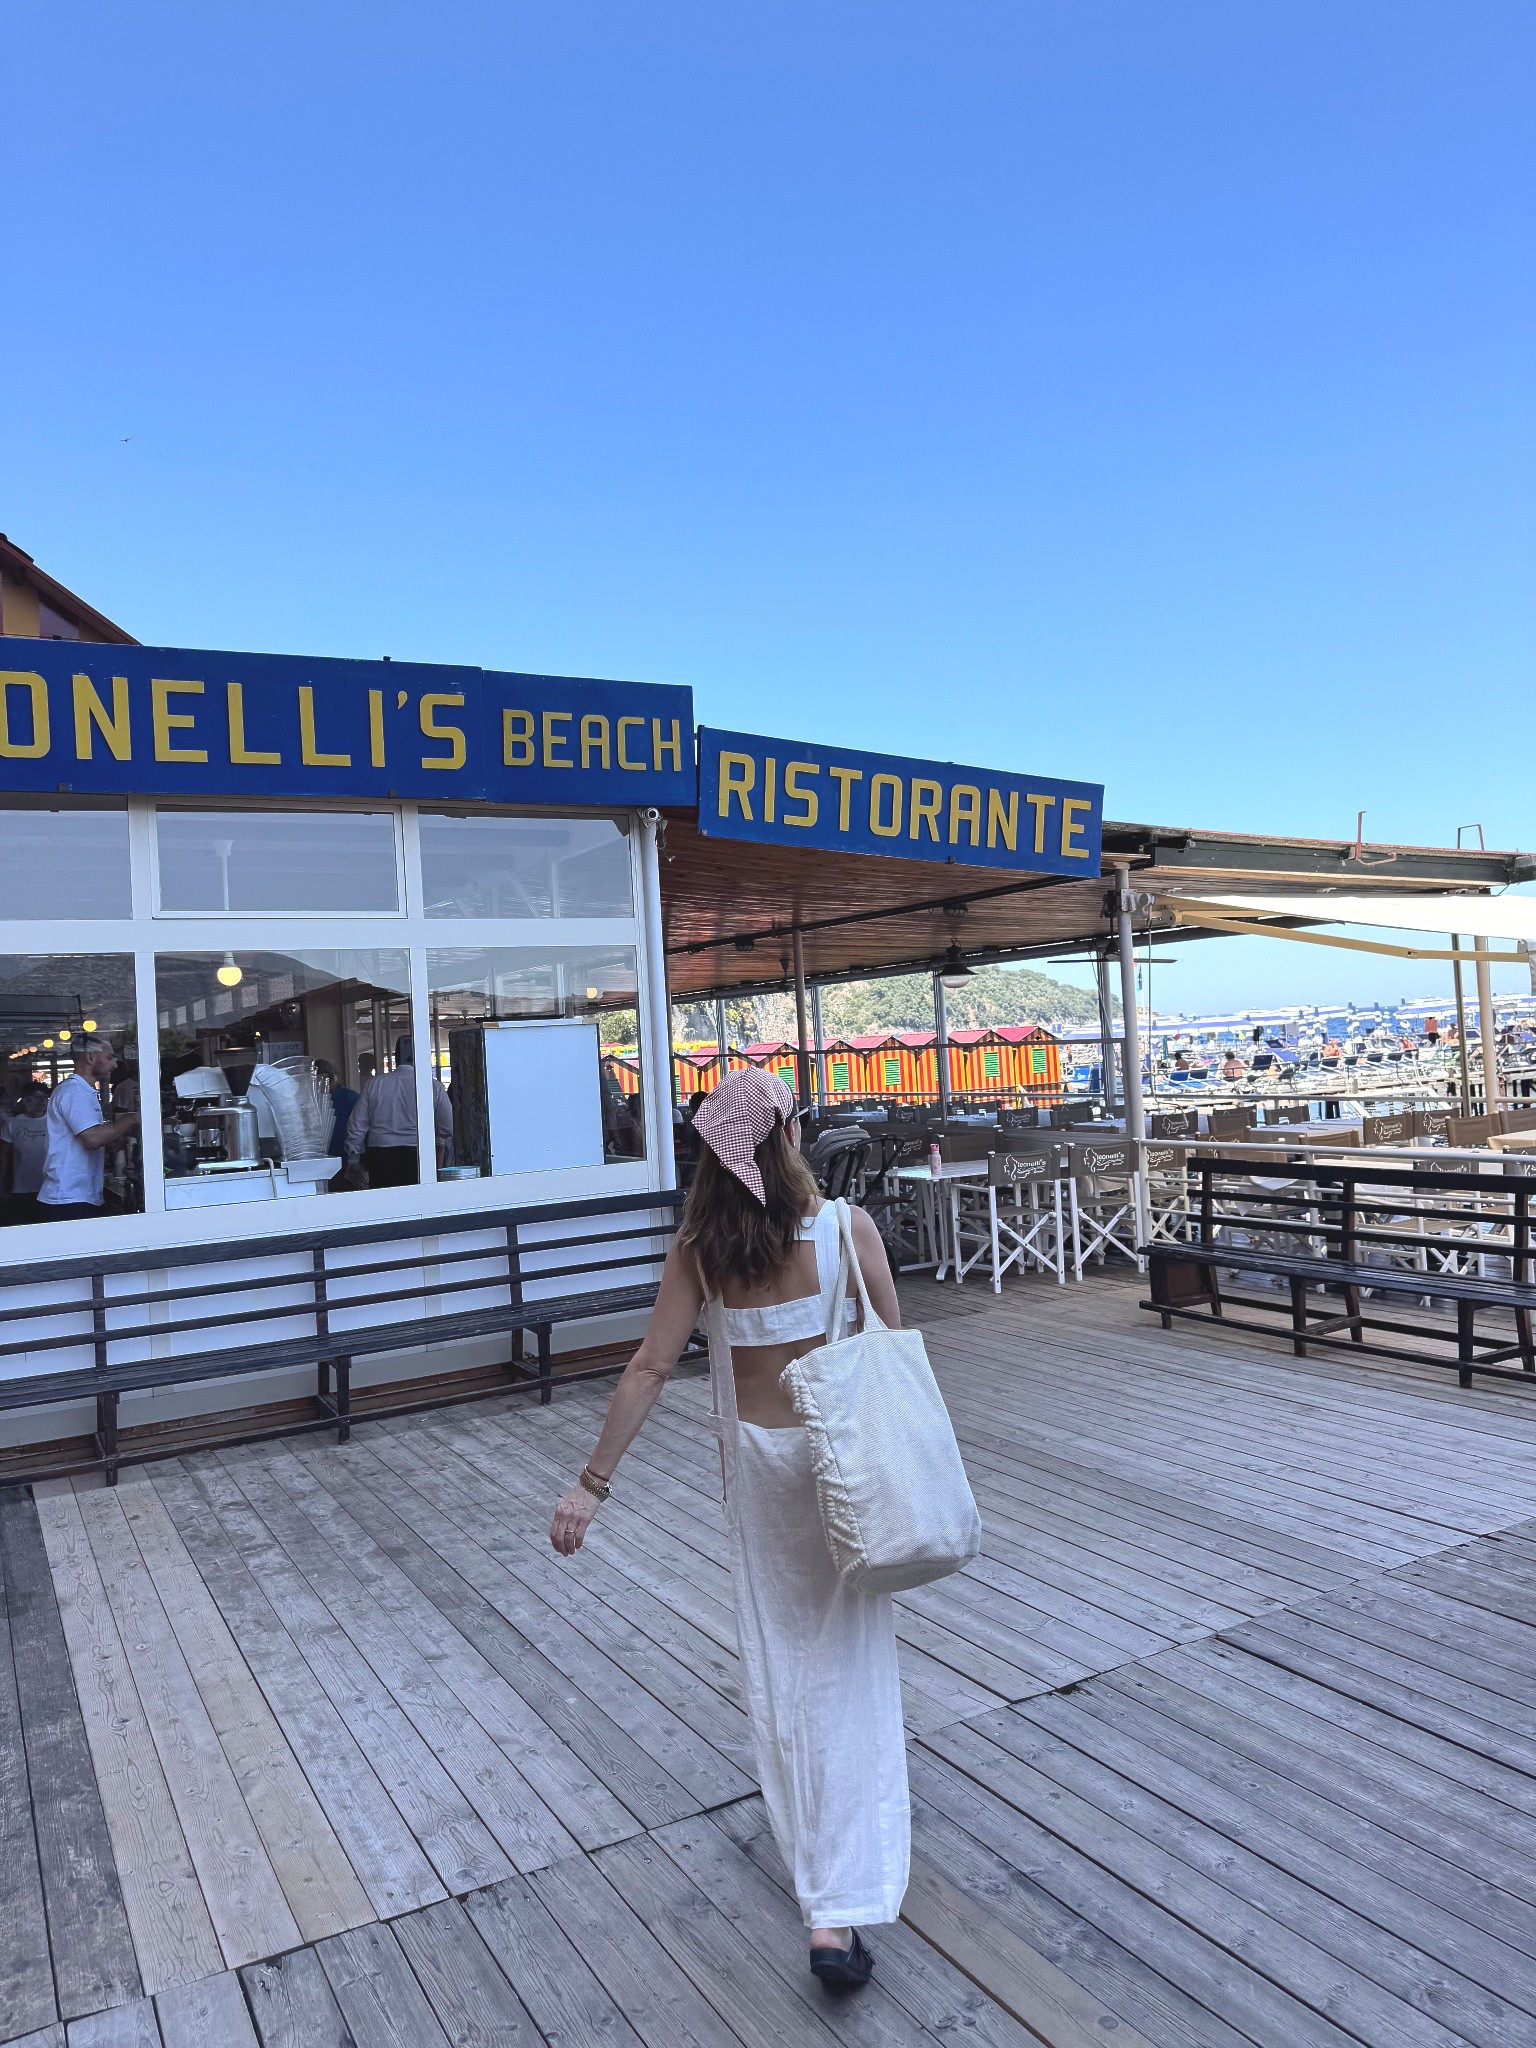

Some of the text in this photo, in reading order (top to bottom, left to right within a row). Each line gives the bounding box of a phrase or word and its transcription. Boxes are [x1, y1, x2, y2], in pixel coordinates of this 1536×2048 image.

[0, 672, 682, 772] ONELLI'S BEACH
[719, 752, 1090, 859] RISTORANTE
